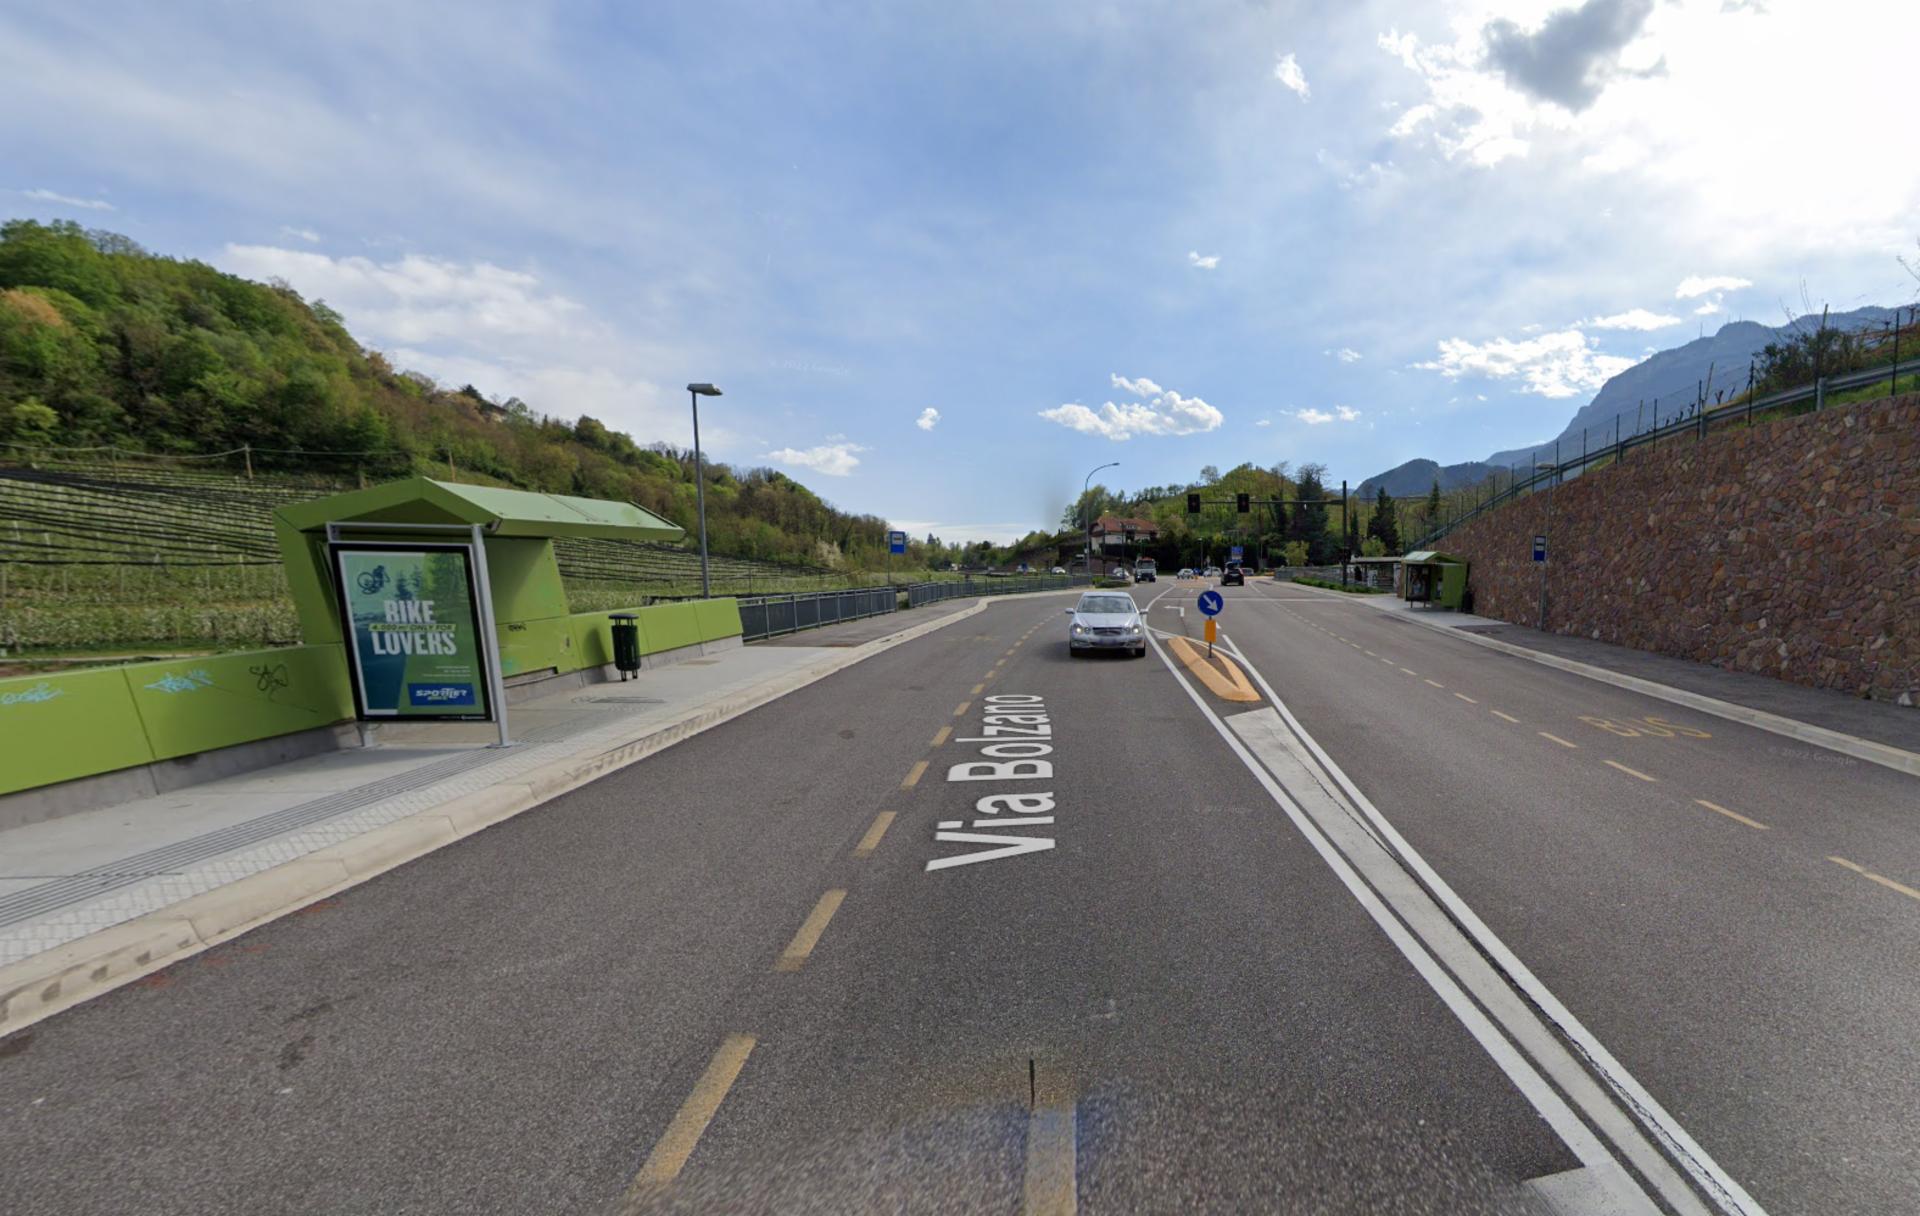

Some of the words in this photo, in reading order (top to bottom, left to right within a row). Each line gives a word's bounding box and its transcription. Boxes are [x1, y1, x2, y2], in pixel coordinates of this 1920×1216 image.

[384, 600, 436, 623] BIKE
[371, 631, 457, 655] LOVERS
[1577, 715, 1713, 738] BUS
